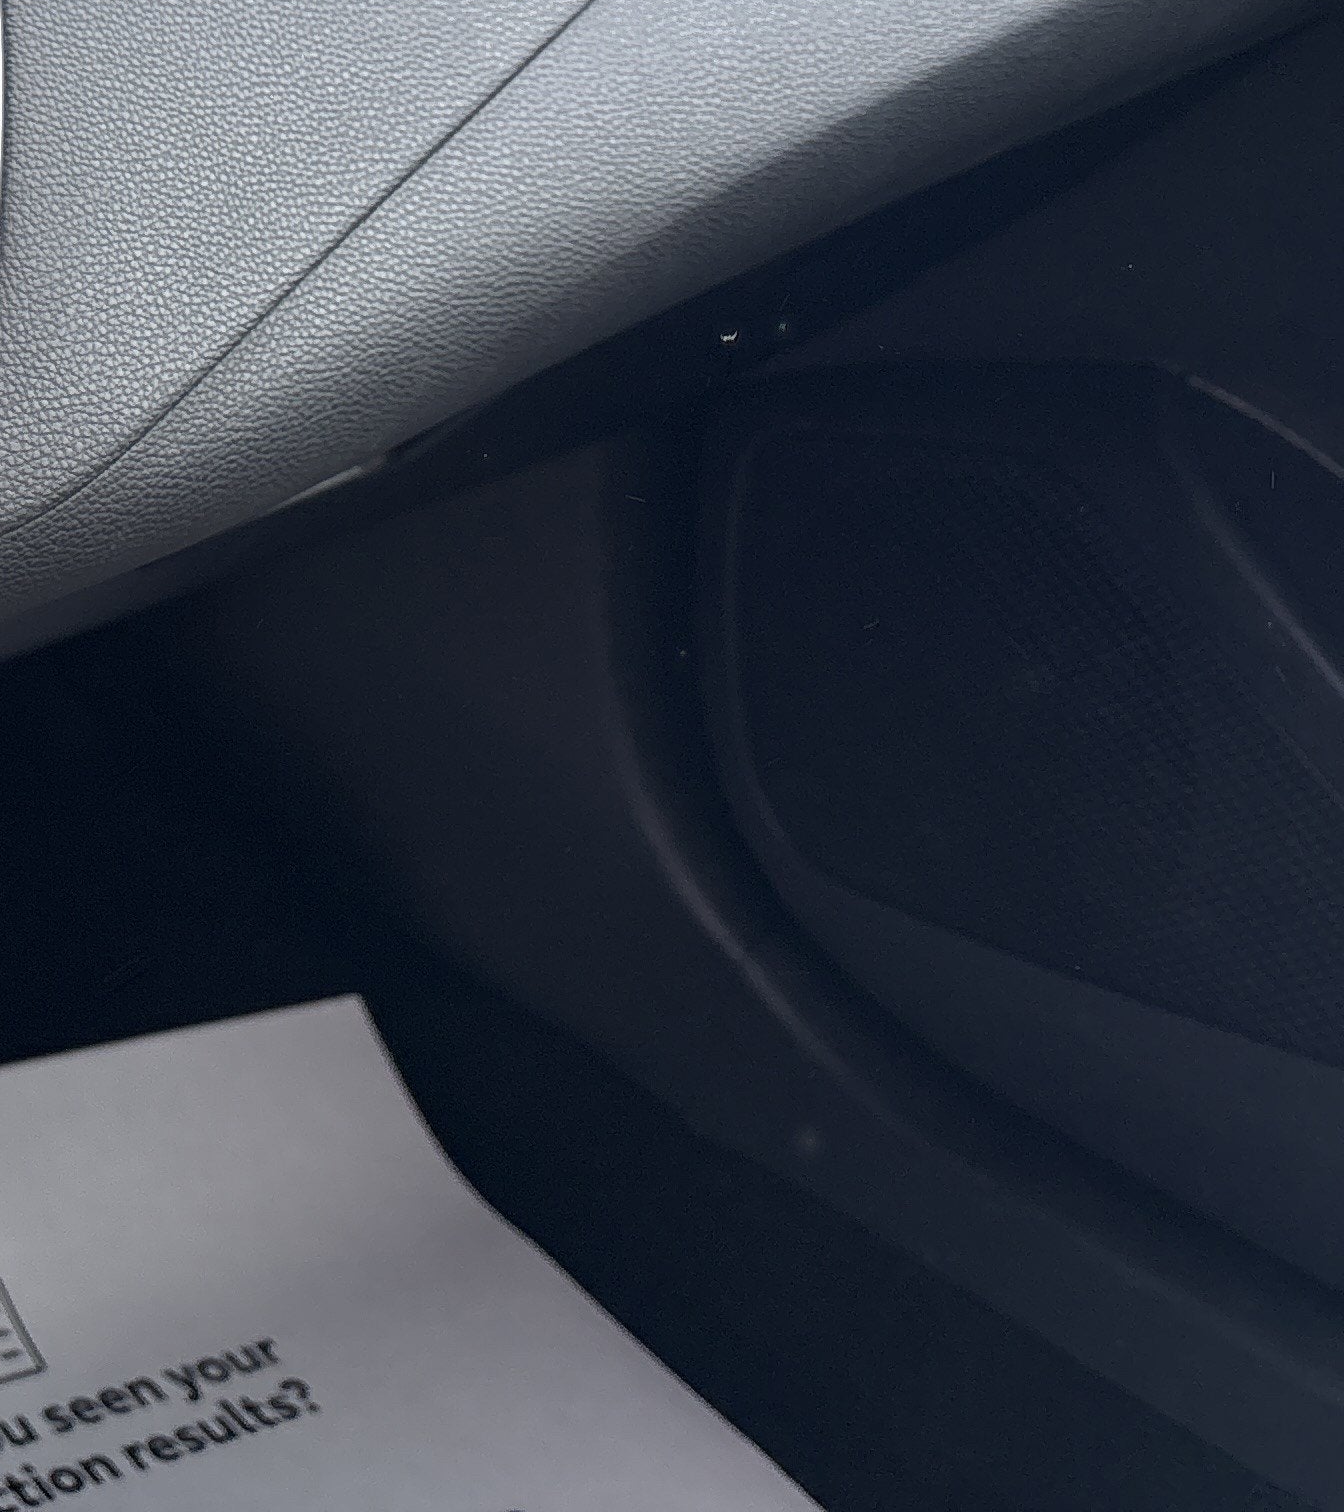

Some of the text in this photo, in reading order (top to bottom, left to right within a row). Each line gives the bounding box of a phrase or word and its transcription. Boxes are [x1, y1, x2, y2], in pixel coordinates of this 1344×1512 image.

[42, 1374, 167, 1435] seen
[161, 1336, 280, 1403] your
[122, 1376, 321, 1471] results?
